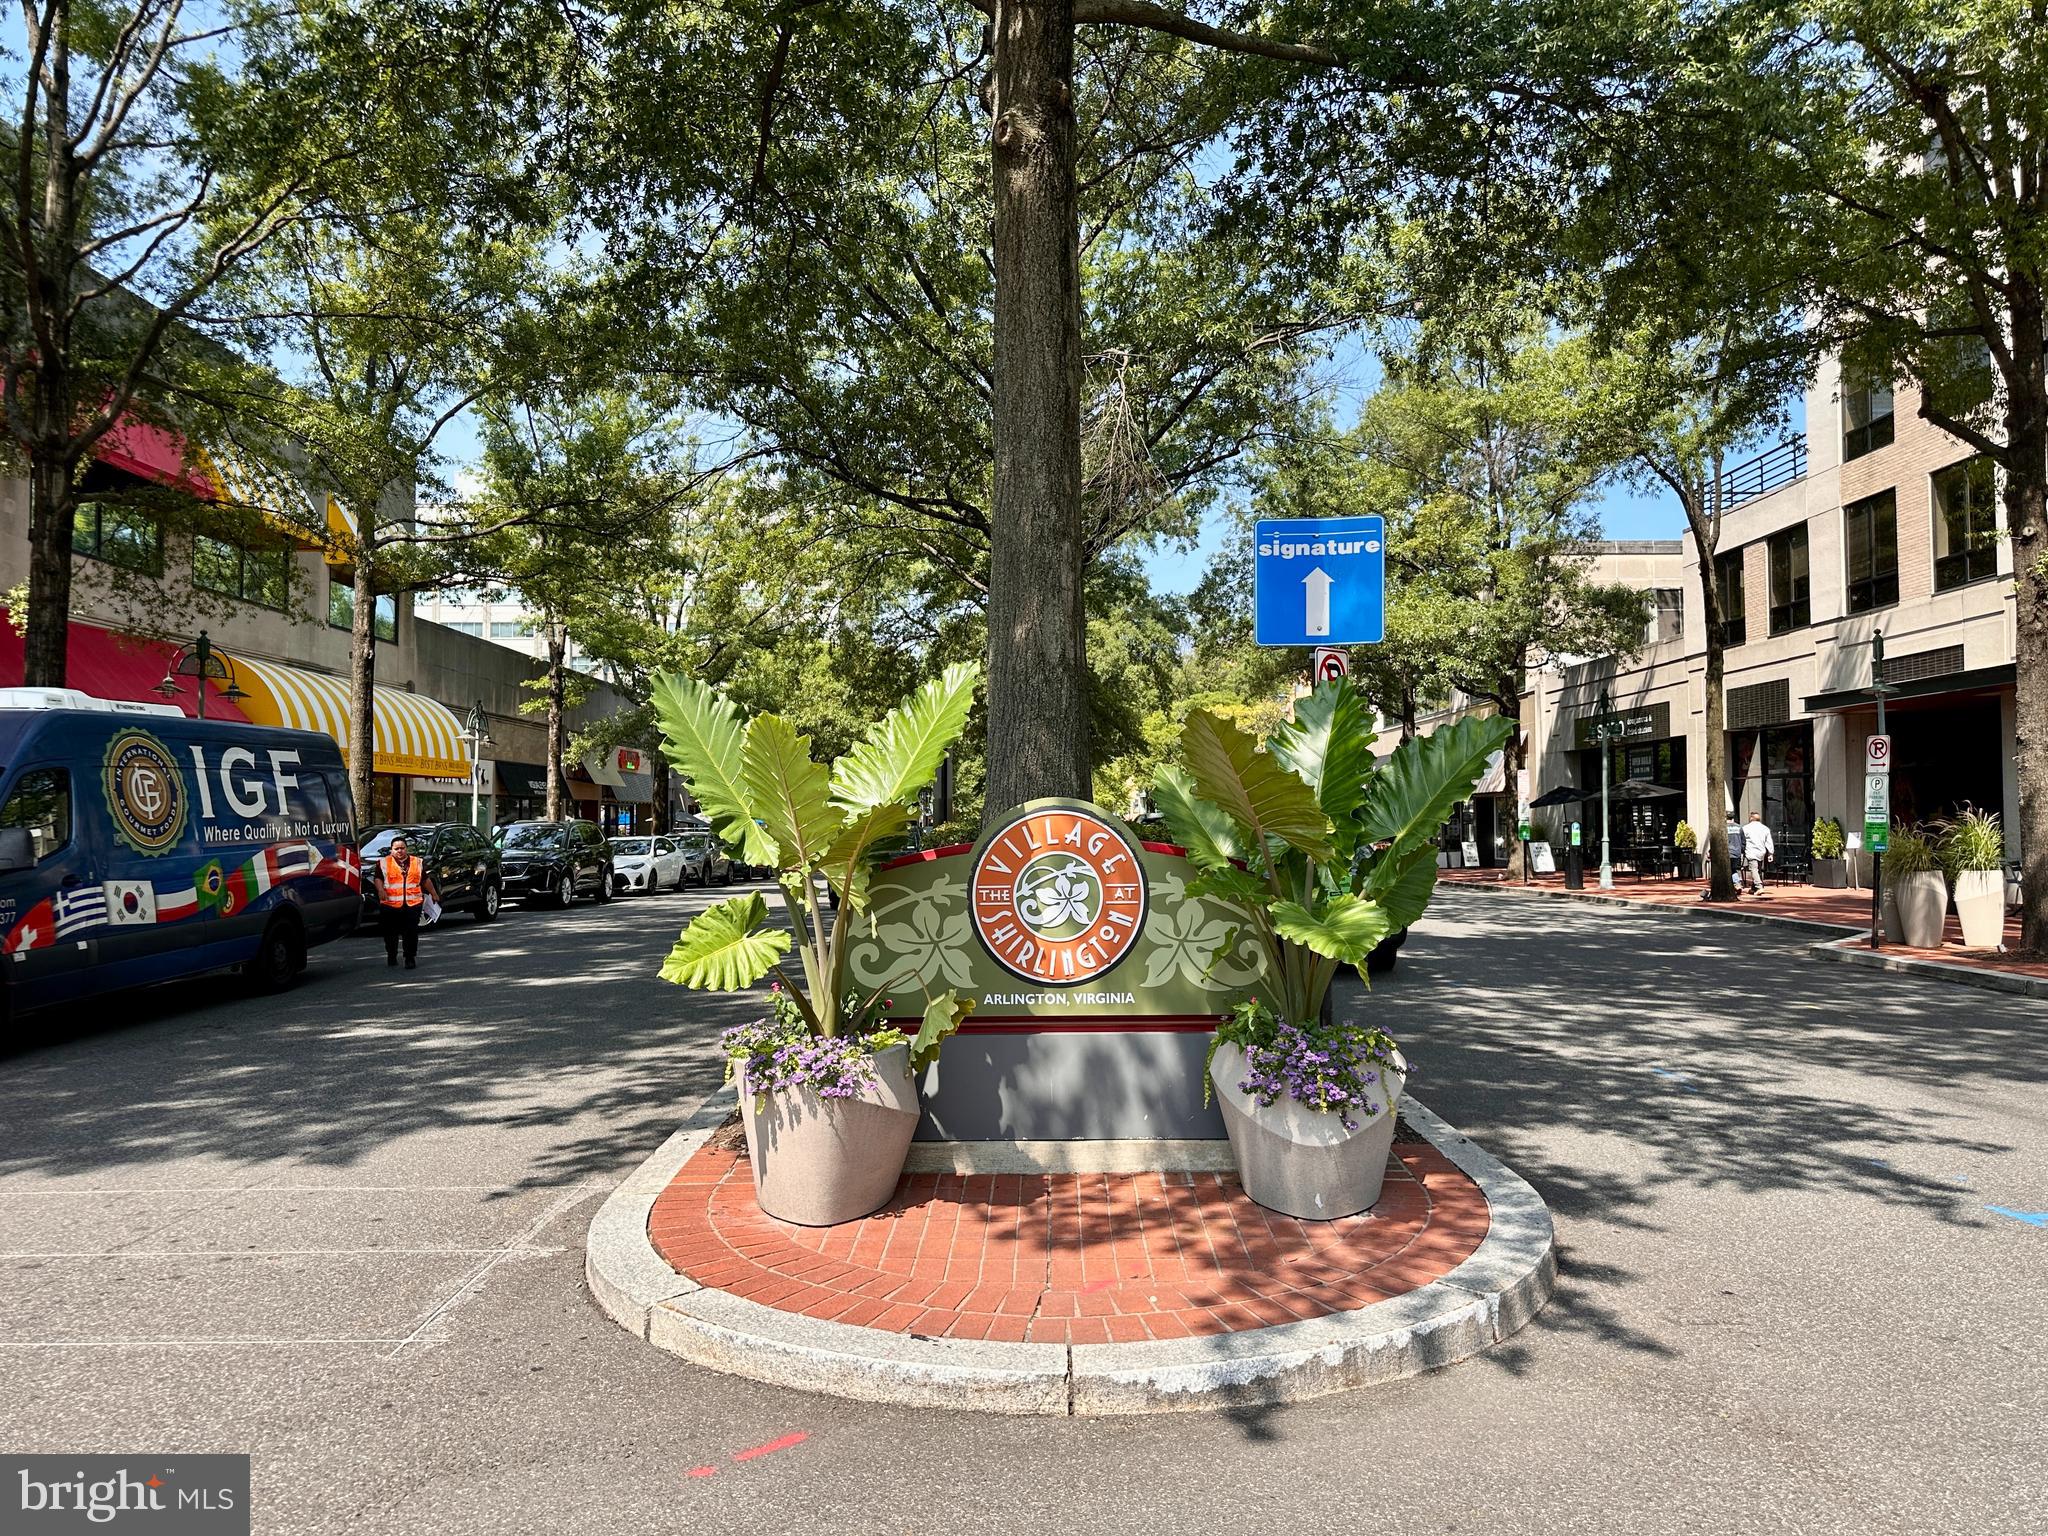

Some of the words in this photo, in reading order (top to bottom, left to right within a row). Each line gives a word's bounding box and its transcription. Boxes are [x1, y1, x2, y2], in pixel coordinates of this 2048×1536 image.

[1259, 540, 1381, 559] signature
[116, 748, 171, 782] INTERNATIONAL
[189, 745, 302, 819] IGF
[119, 799, 157, 835] GOURMET
[160, 801, 177, 833] FOODS
[203, 826, 242, 842] Where
[244, 824, 281, 842] Quality
[284, 823, 292, 837] is
[294, 822, 311, 837] Not
[313, 826, 319, 835] a
[322, 821, 350, 837] Luxury
[986, 818, 1127, 875] VILLAGE
[979, 889, 1010, 901] THE
[1114, 887, 1136, 899] AT
[981, 910, 1134, 977] SHIRLINGTON
[984, 993, 1069, 1006] ARLINGTON,
[1073, 992, 1135, 1005] VIRGINIA
